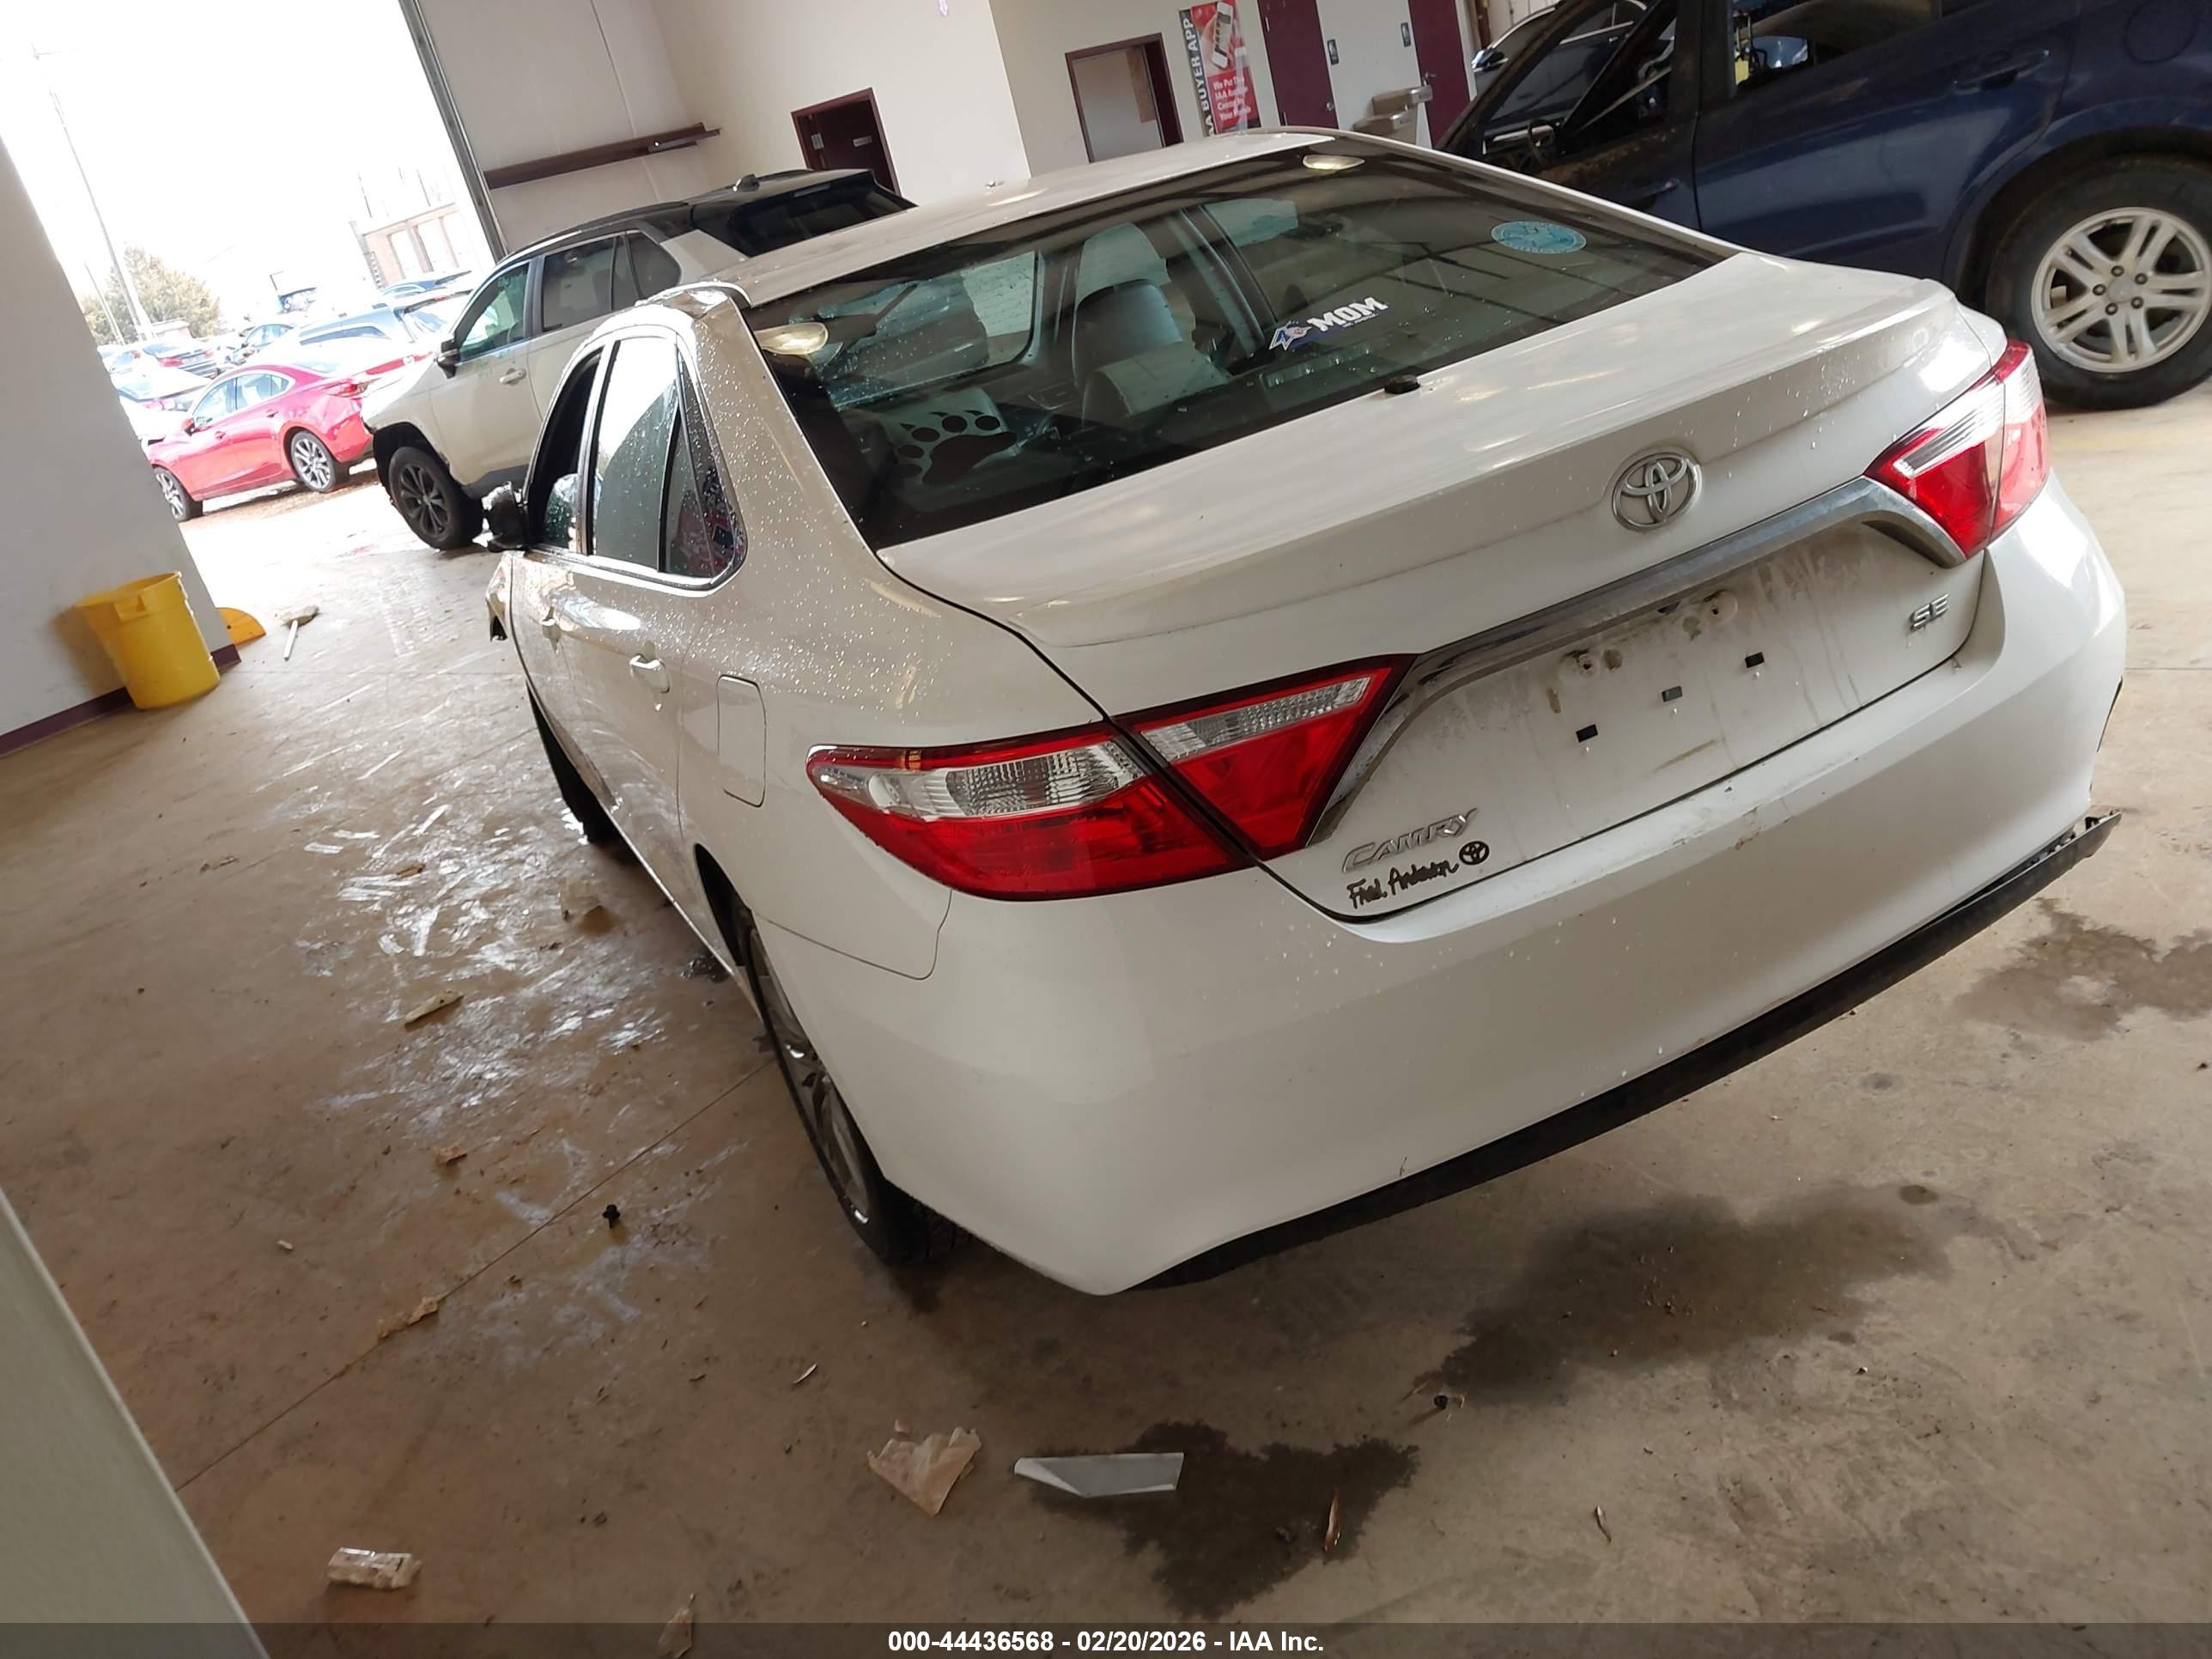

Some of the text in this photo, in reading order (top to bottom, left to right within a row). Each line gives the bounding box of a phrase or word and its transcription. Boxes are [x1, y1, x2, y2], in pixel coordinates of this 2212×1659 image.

[1183, 18, 1198, 51] APP
[1191, 56, 1210, 111] BUYER
[1306, 296, 1389, 332] MOM
[1909, 593, 1949, 632] SE
[1341, 808, 1477, 873] CAMRY
